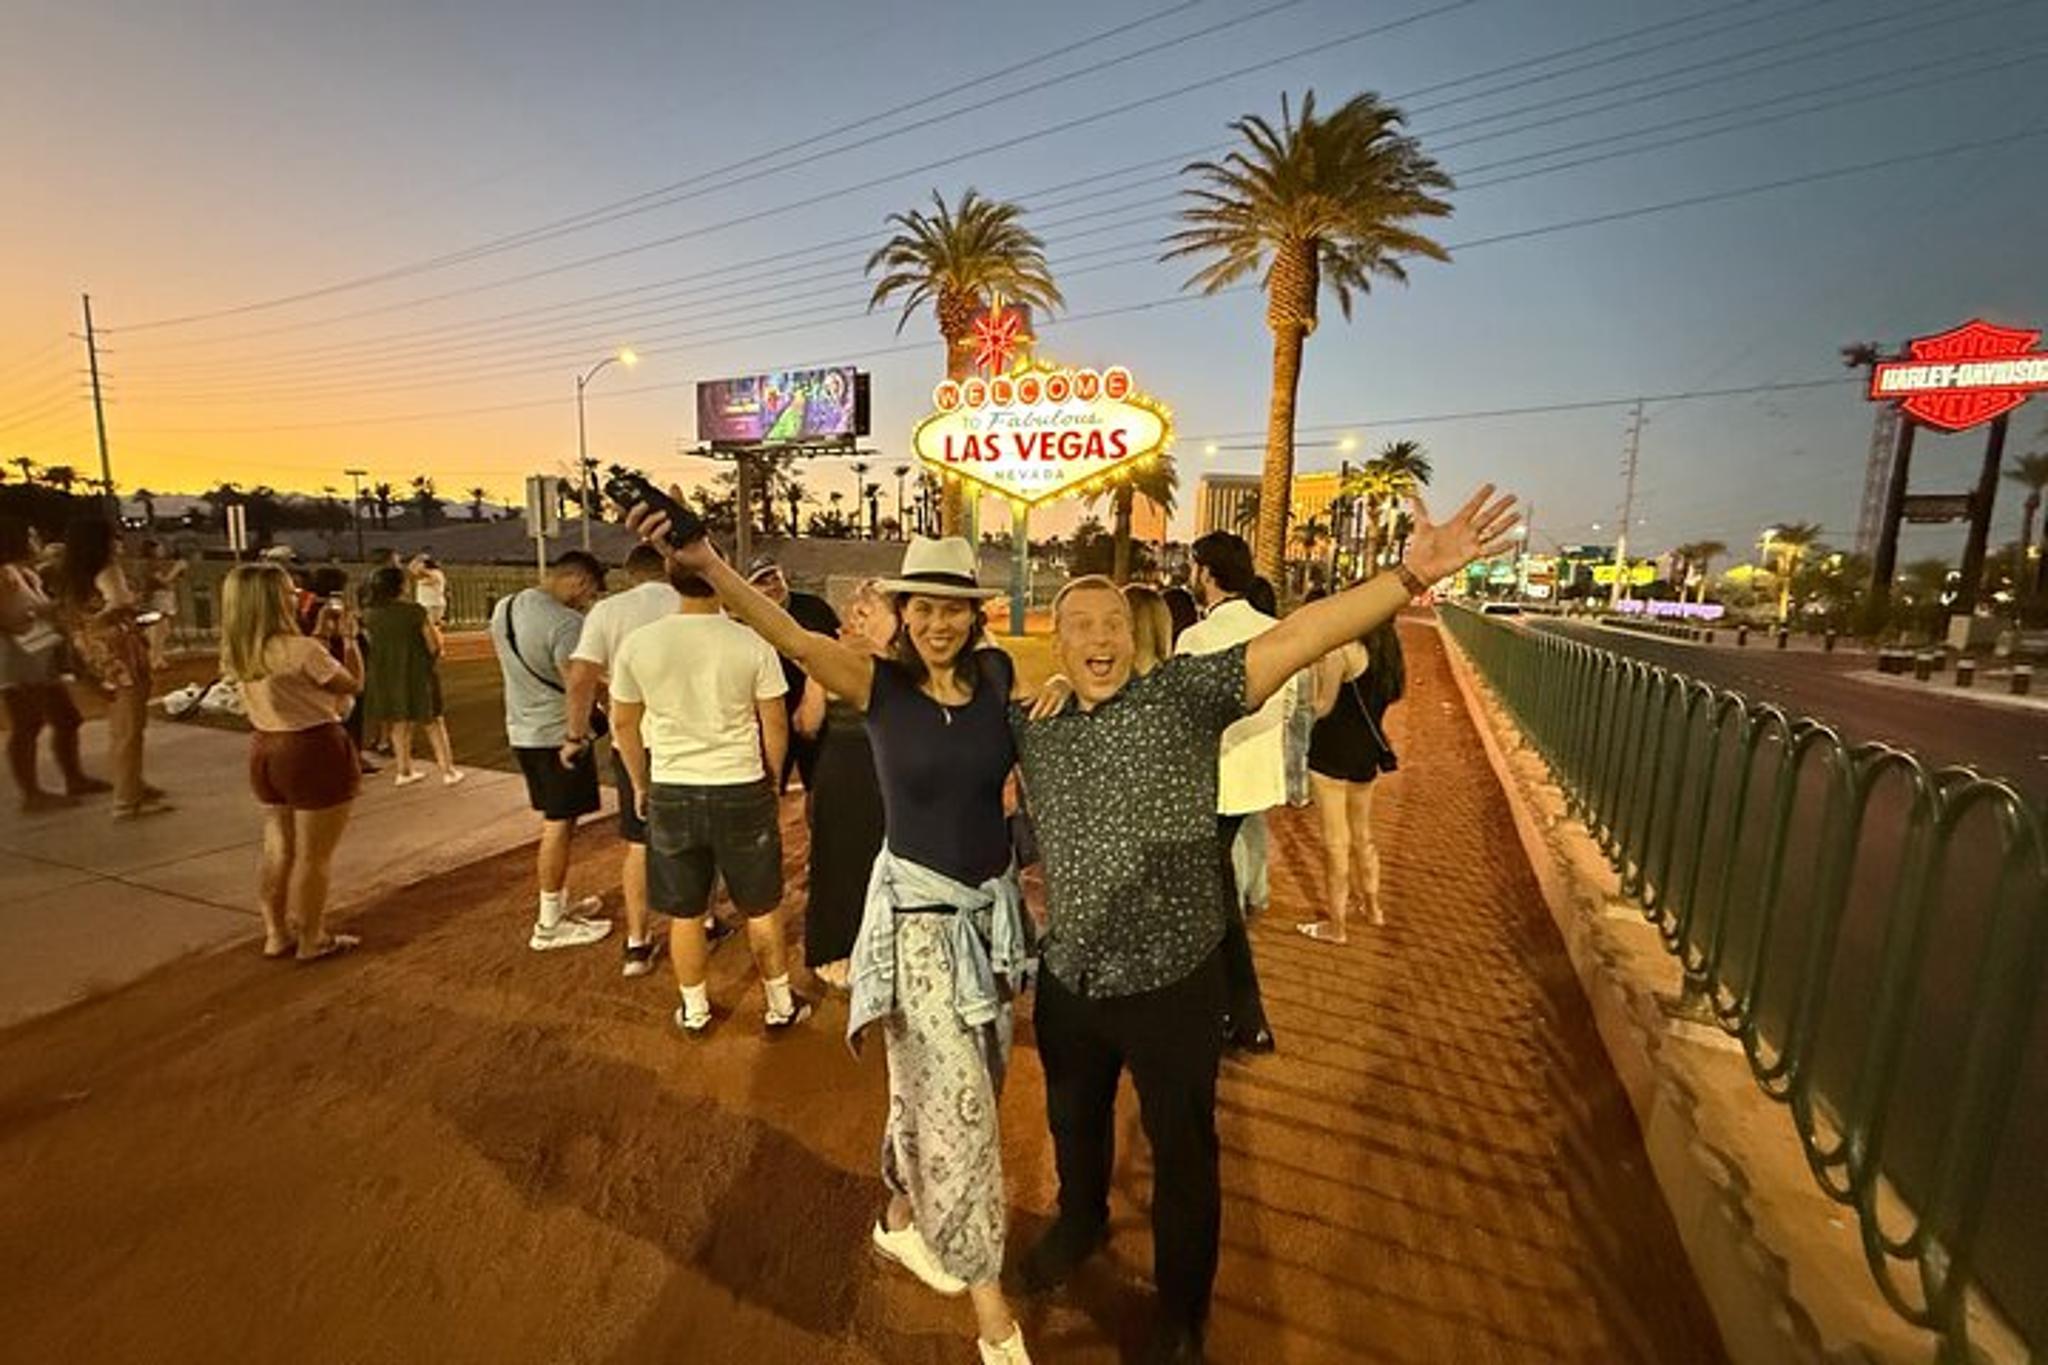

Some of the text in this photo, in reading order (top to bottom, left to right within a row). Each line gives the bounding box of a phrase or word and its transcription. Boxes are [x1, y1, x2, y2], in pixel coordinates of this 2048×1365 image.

[937, 371, 1128, 409] WELCOME
[987, 409, 1104, 430] Fabulous
[945, 429, 1127, 462] LAS VEGAS
[995, 469, 1065, 481] NEVADA
